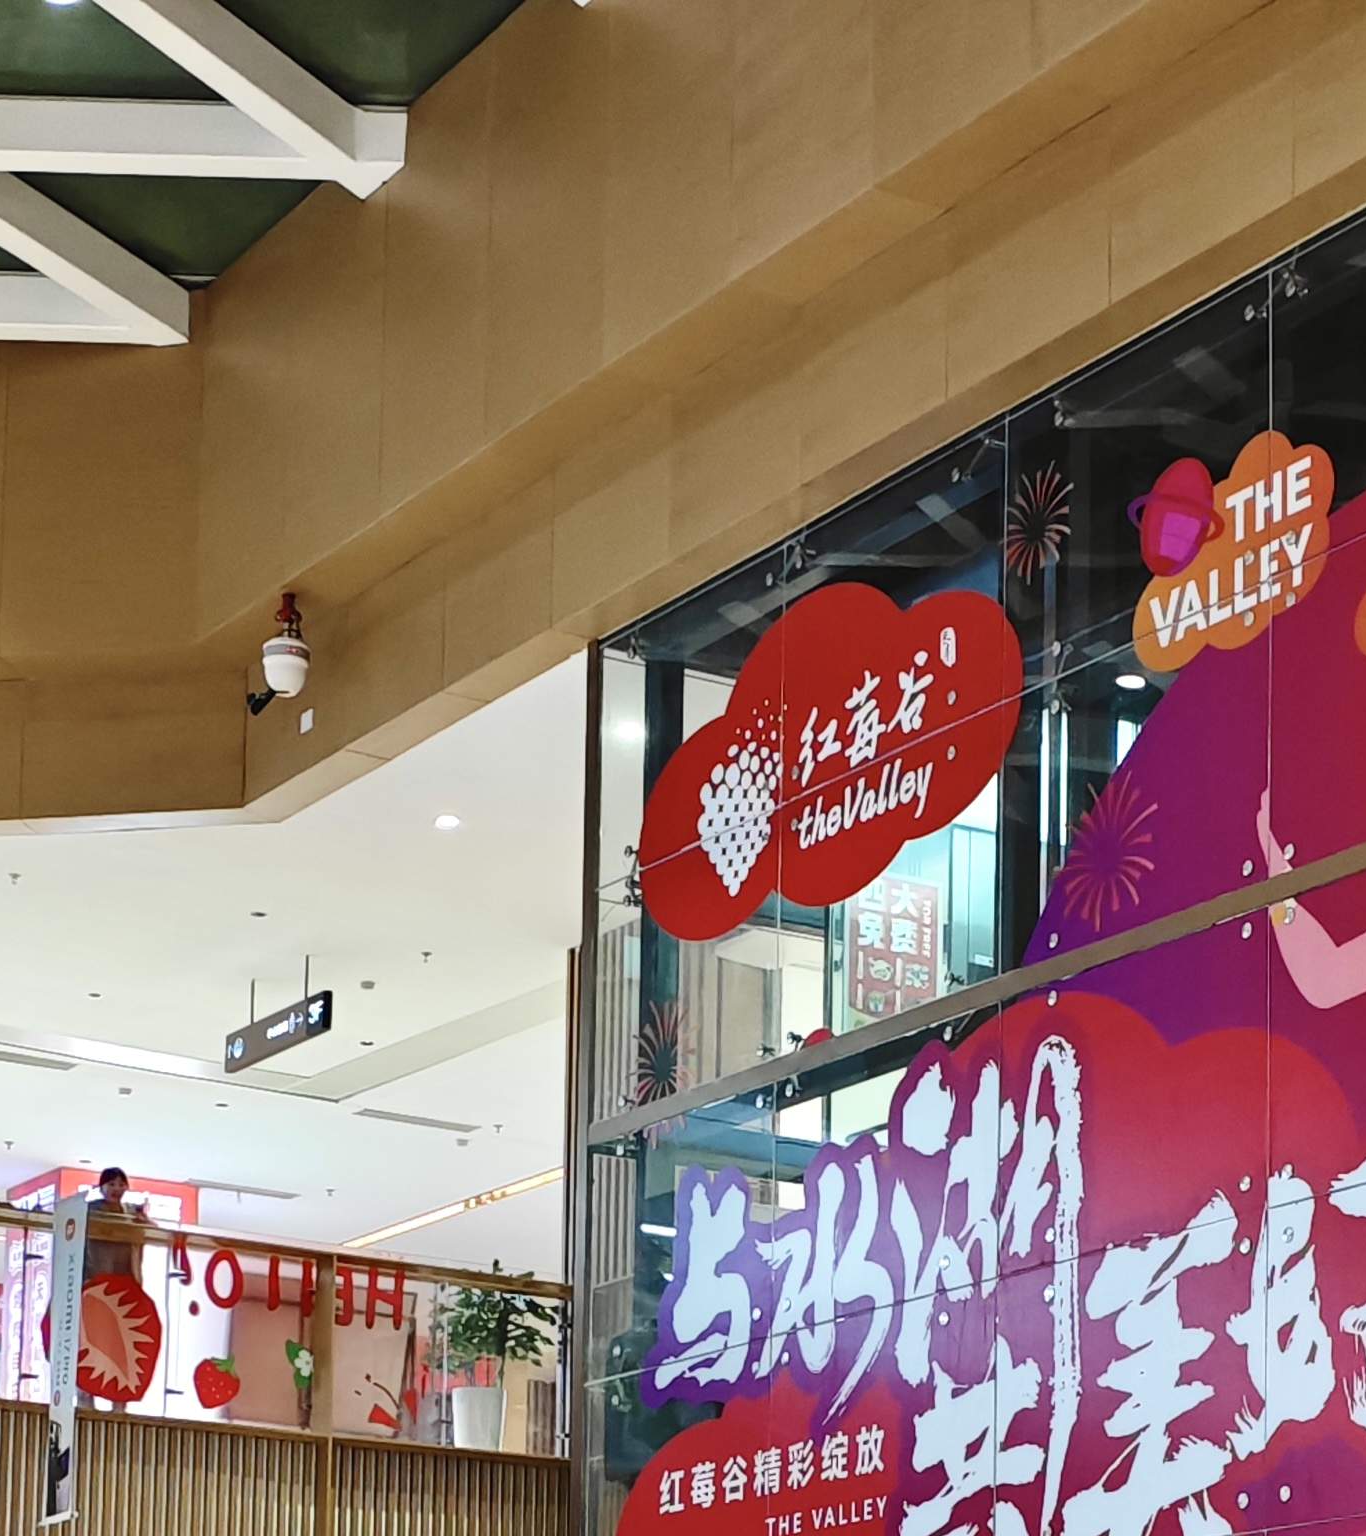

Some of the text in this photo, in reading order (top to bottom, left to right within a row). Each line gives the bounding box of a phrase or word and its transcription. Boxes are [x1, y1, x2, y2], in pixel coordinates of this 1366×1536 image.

[1225, 454, 1315, 544] THE
[1148, 522, 1311, 648] VALLEY
[797, 649, 934, 788] 红莓谷
[657, 1424, 887, 1516] 红莓谷精彩绽放
[811, 1495, 888, 1534] VALLEY
